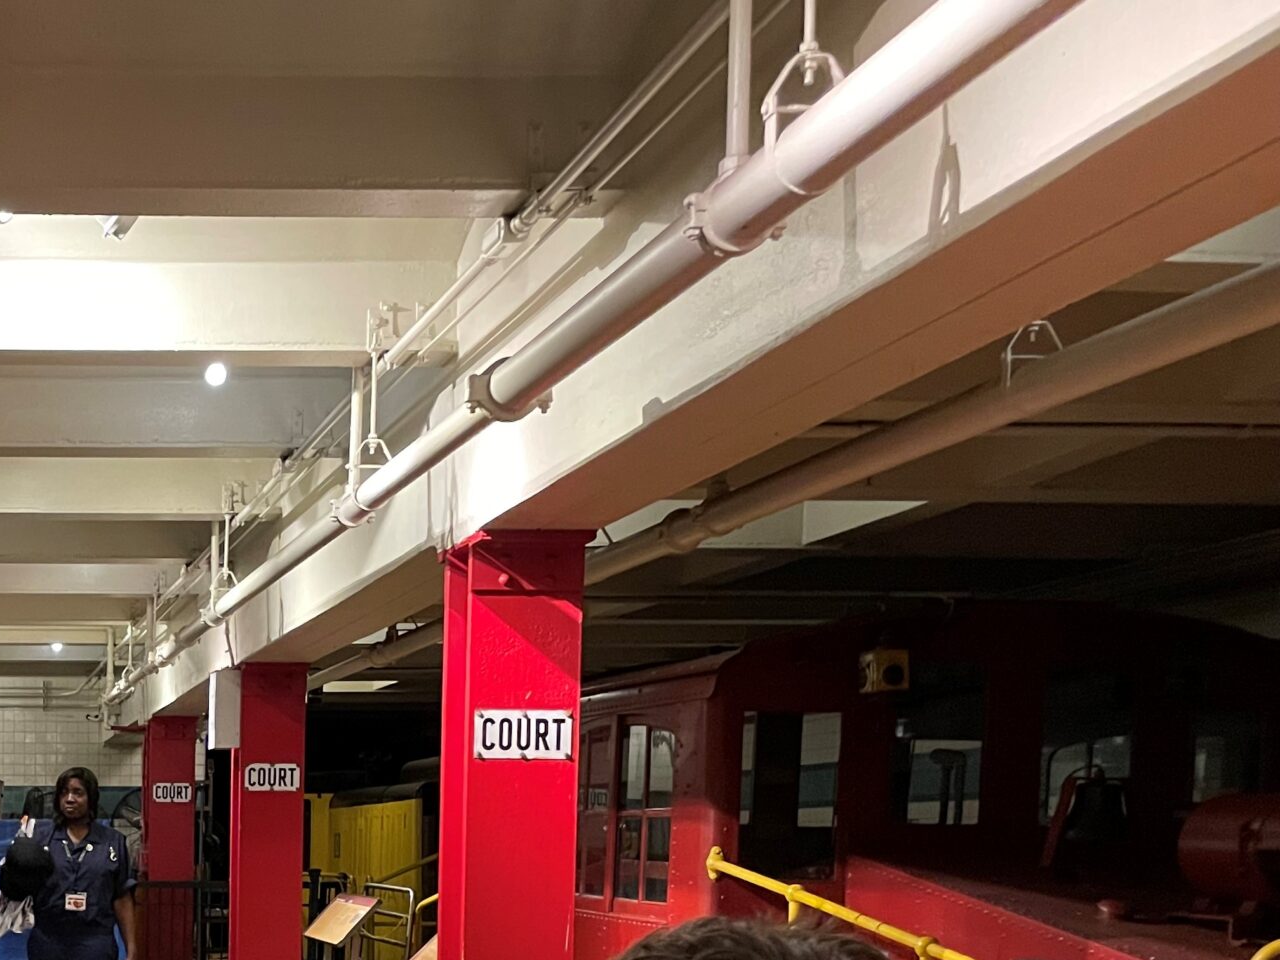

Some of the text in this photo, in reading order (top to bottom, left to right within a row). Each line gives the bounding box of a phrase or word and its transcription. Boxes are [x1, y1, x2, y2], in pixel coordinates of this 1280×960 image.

[481, 717, 567, 752] COURT
[248, 767, 297, 787] COURT
[154, 785, 190, 800] COURT
